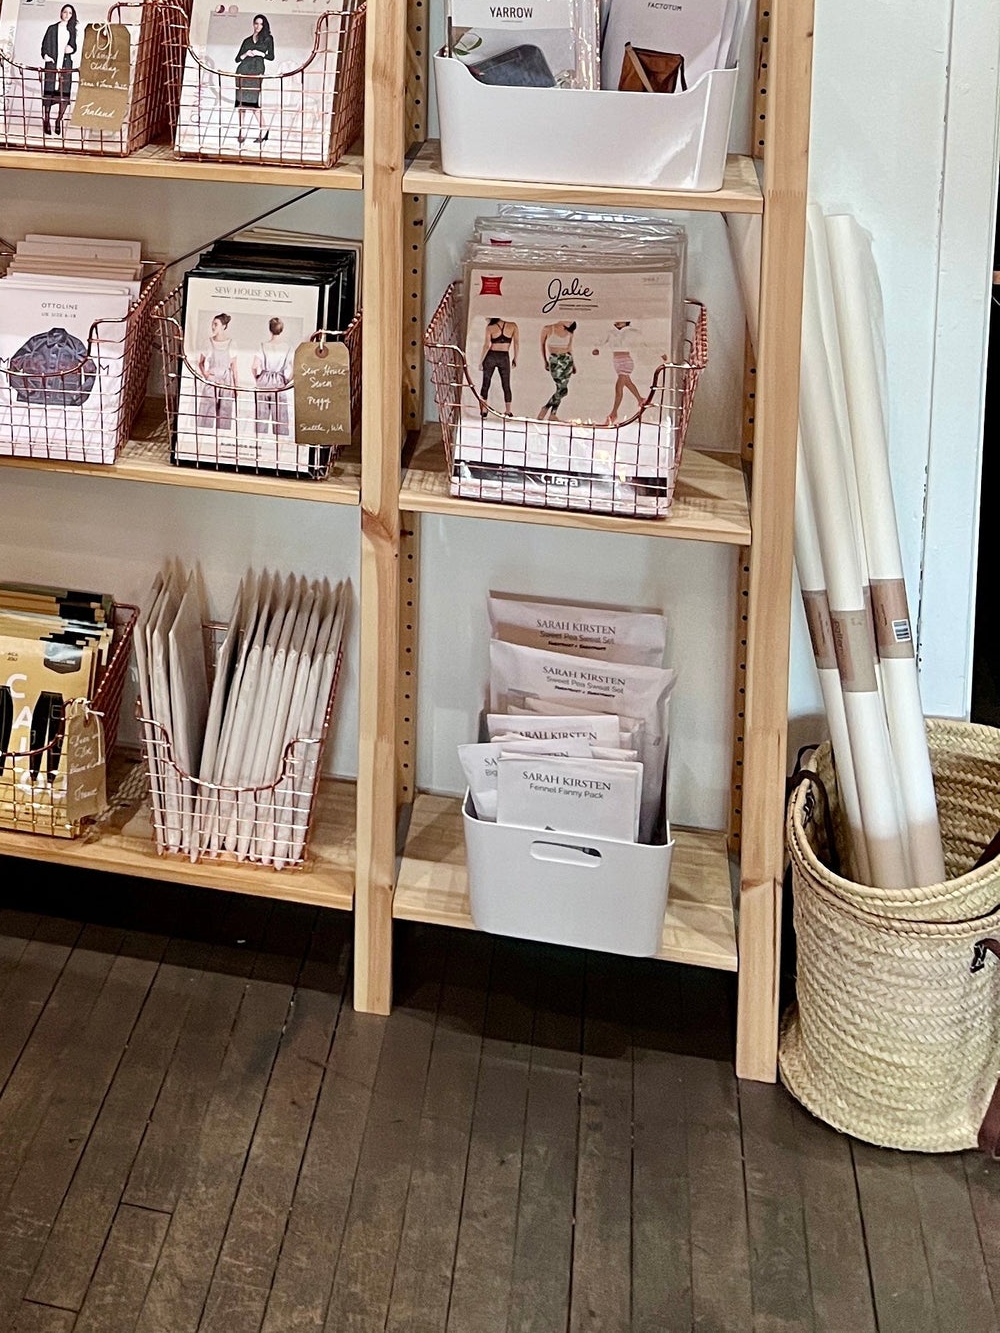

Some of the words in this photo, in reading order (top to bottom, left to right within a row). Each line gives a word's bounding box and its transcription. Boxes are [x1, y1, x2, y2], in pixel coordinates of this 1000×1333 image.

[489, 6, 533, 19] YARROW
[647, 2, 682, 12] FACTOTUM
[214, 286, 231, 295] SEW
[233, 288, 262, 297] HOUSE
[264, 290, 290, 299] SEVEN
[542, 278, 594, 314] Jalie
[41, 302, 78, 310] OTTOLINE
[540, 473, 580, 487] Clara
[536, 619, 570, 631] SARAH
[572, 622, 616, 635] KIRSTEN
[540, 630, 563, 639] Sweet
[564, 632, 578, 641] Pea
[578, 633, 601, 642] Sweat
[602, 637, 615, 645] Set
[542, 666, 577, 679] SARAH
[579, 671, 626, 687] KIRSTEN
[546, 675, 570, 686] Sweet
[570, 679, 586, 688] Pea
[586, 681, 610, 691] Sweat
[611, 686, 624, 694] Set
[513, 730, 548, 740] ARAH
[551, 731, 598, 740] KIRSTEN
[522, 770, 560, 784] SARAH
[562, 776, 612, 791] KIRSTEN
[529, 782, 557, 794] Fennel
[558, 786, 583, 799] Fanny
[584, 790, 604, 800] Pack
